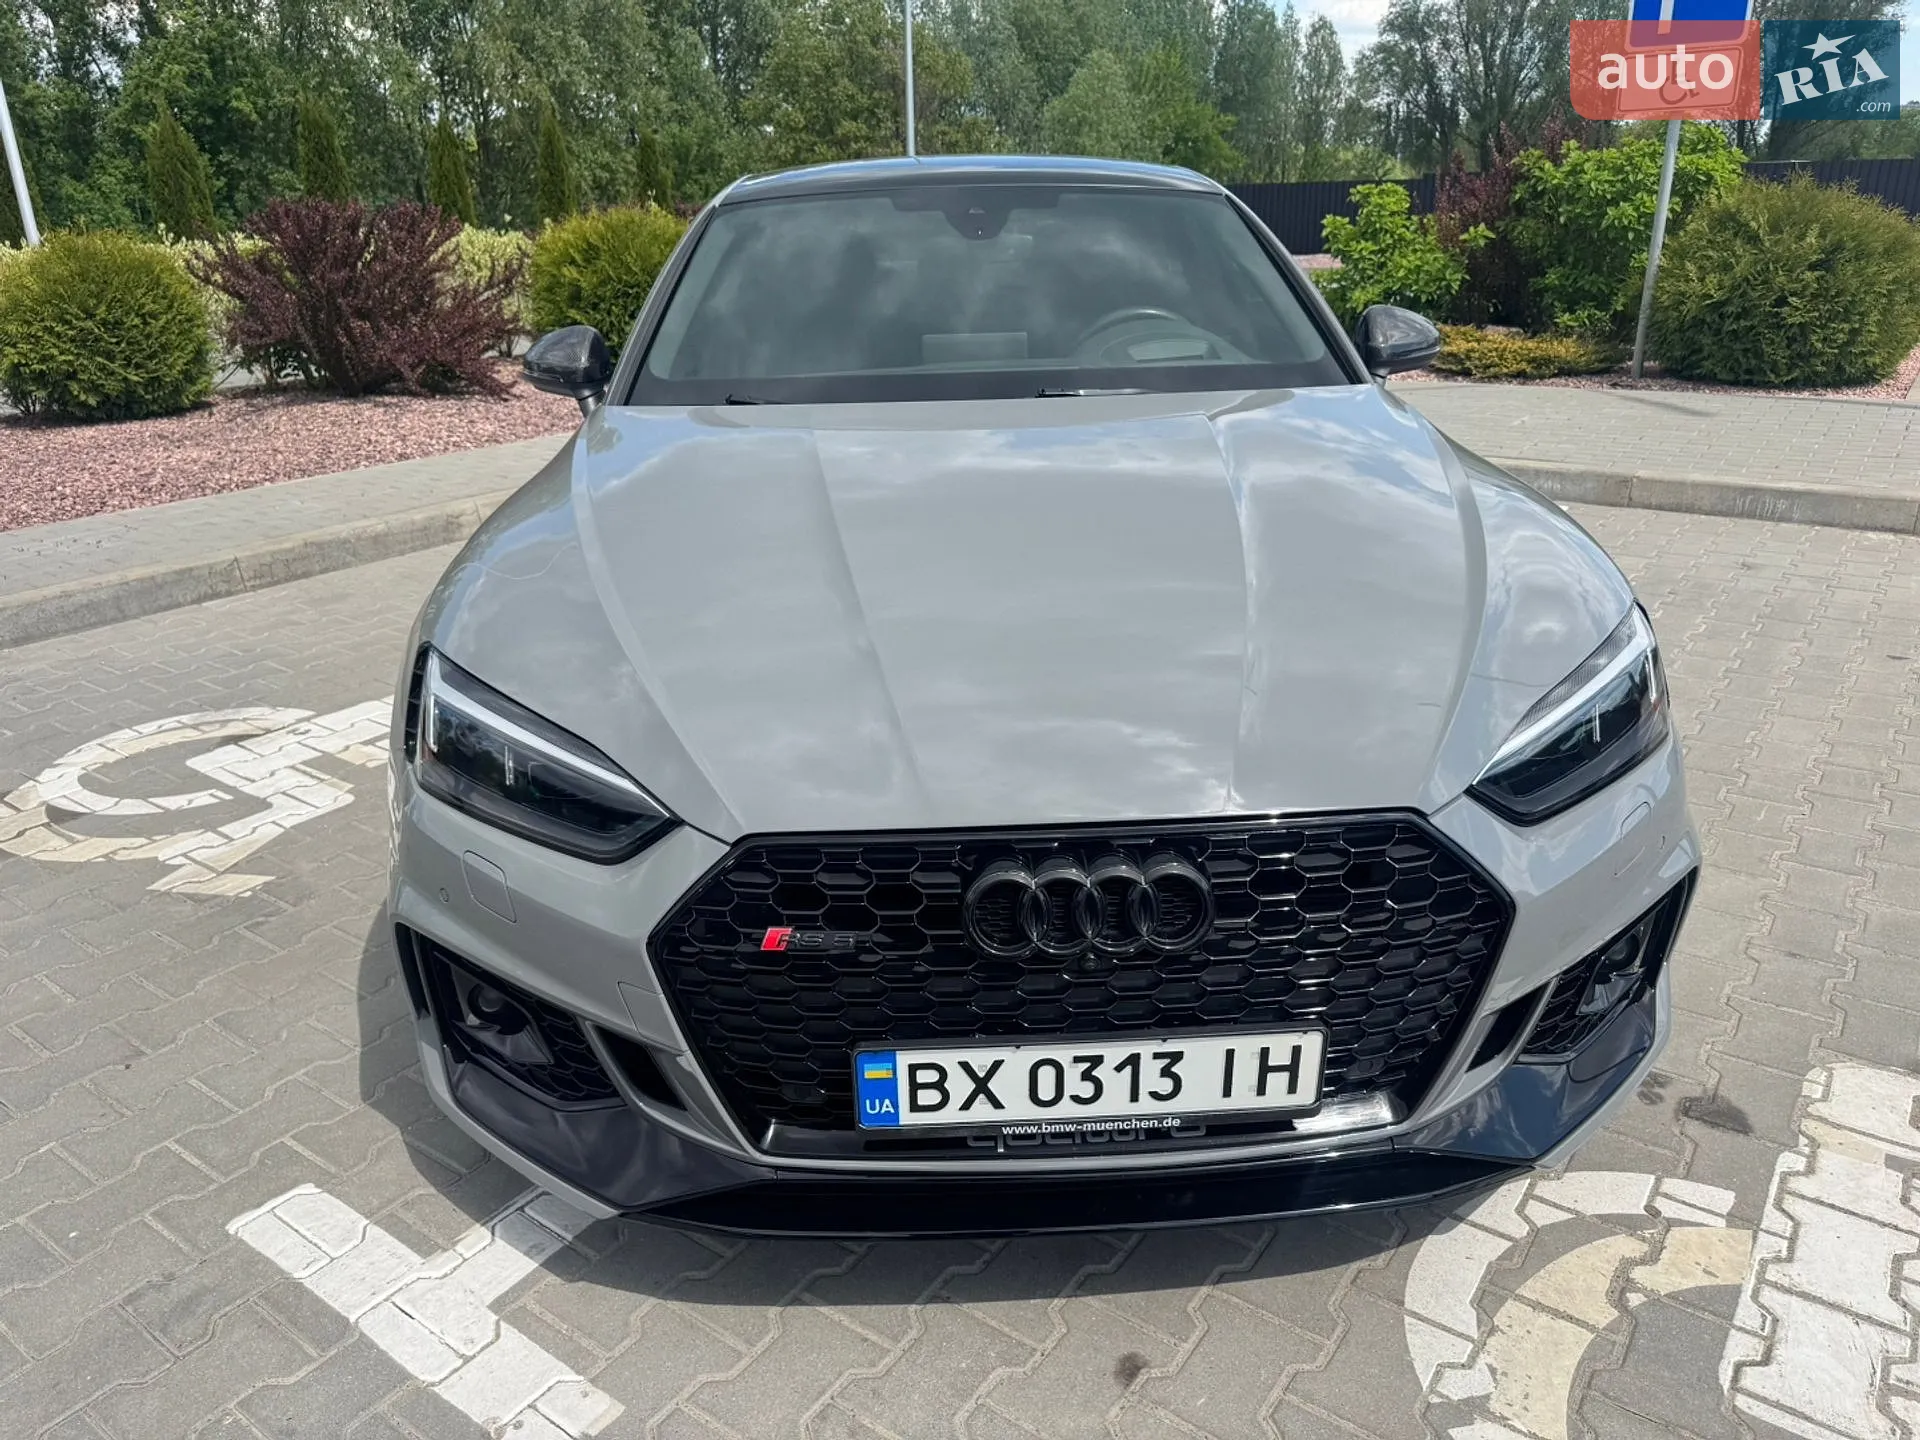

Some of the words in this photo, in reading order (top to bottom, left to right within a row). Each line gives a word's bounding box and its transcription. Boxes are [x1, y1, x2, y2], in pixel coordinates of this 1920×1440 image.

[907, 1059, 1006, 1113] BX
[1028, 1050, 1185, 1108] 0313
[1221, 1044, 1303, 1099] IH
[865, 1098, 895, 1115] UA
[1001, 1116, 1182, 1136] www.bmw-muenchen.de
